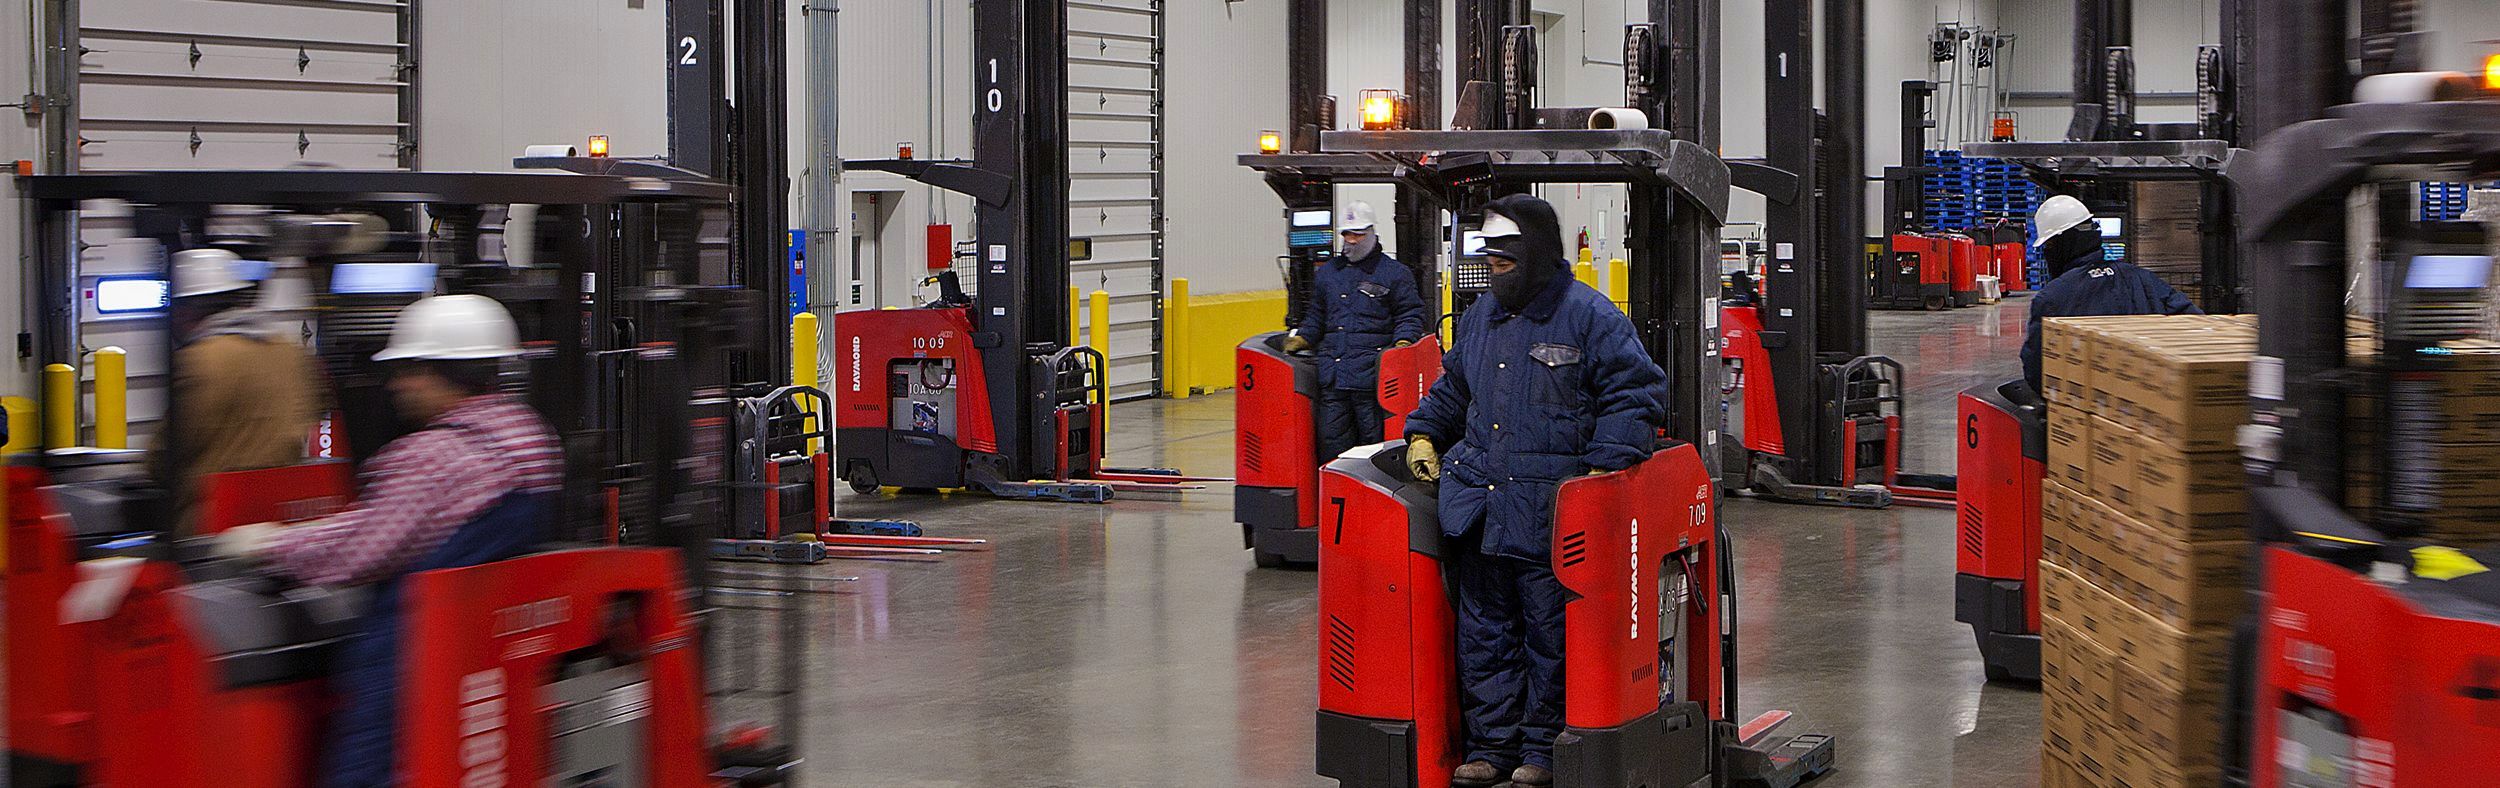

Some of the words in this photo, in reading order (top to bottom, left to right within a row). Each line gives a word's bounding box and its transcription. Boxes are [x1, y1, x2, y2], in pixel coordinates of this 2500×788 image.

[680, 36, 697, 65] 2
[1778, 52, 1787, 77] 1
[1241, 363, 1255, 391] 3
[1967, 413, 1979, 450] 6
[1331, 497, 1346, 545] 7
